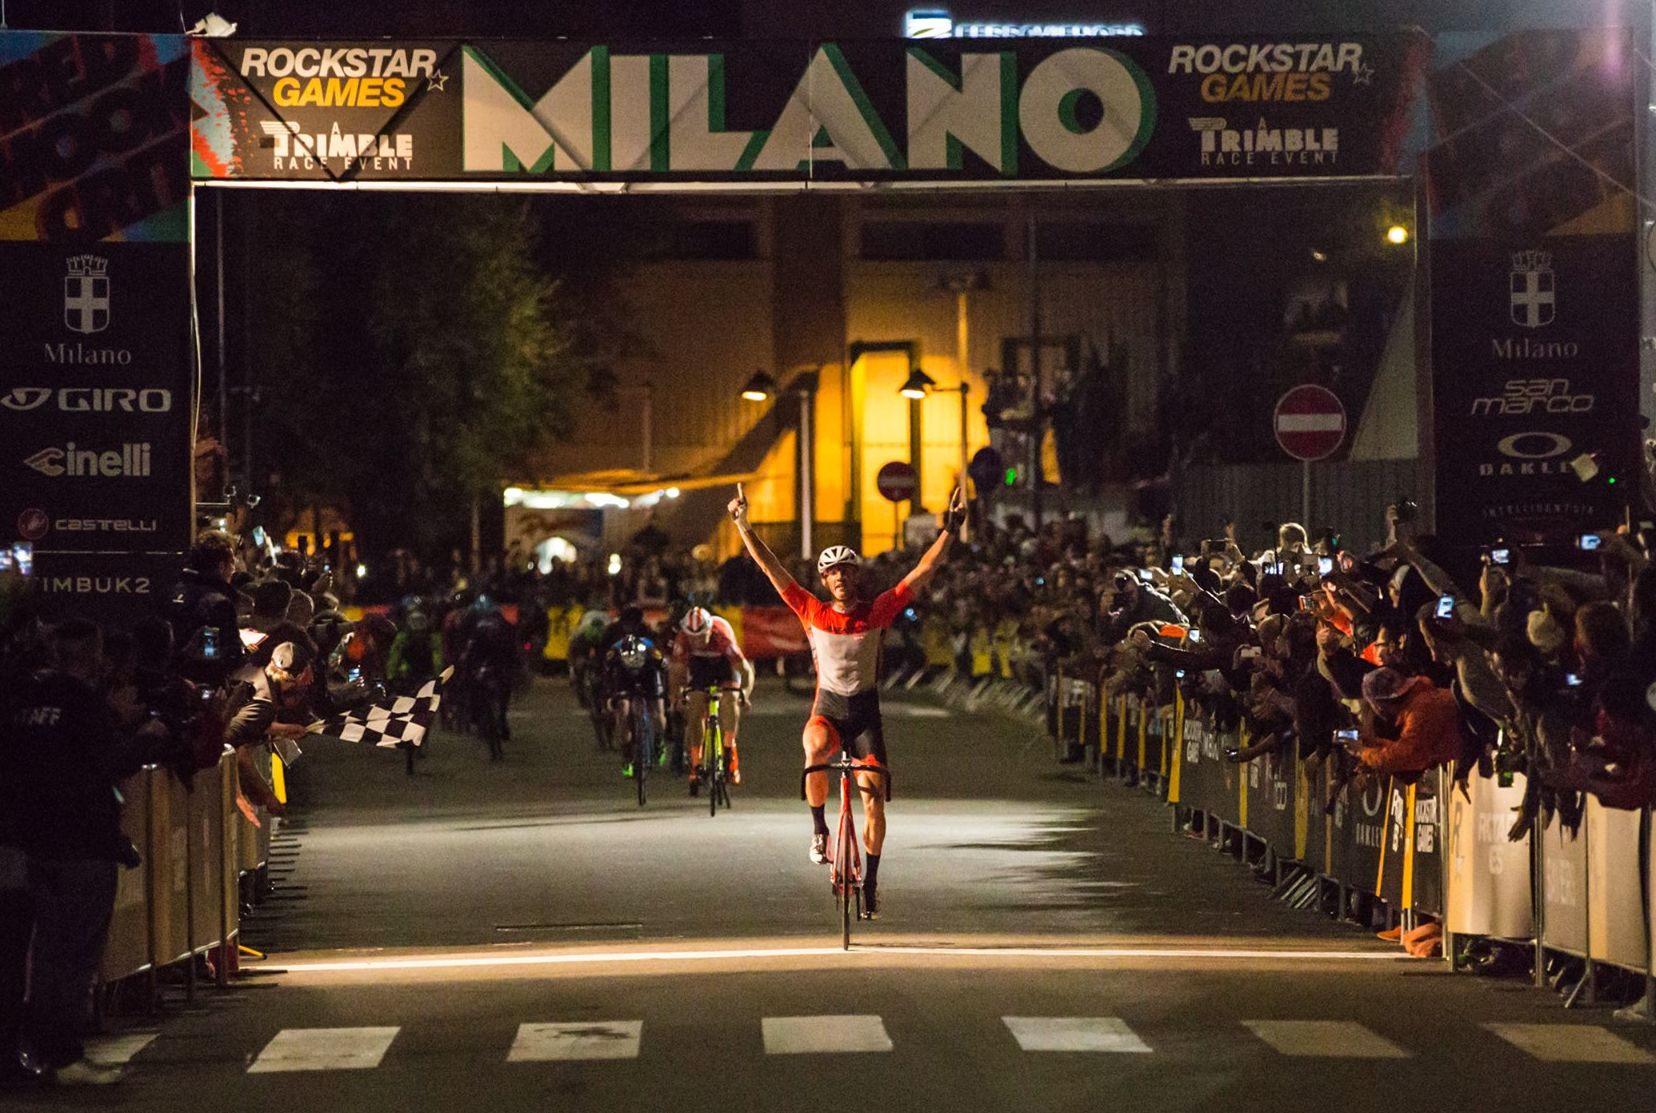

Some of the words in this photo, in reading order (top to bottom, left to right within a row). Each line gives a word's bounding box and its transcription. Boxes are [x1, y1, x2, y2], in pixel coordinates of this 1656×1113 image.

[241, 48, 437, 77] ROCKSTAR
[1168, 43, 1362, 74] ROCKSTAR
[273, 78, 406, 107] GAMES
[1201, 72, 1331, 103] GAMES
[462, 43, 1158, 173] MILANO
[260, 121, 413, 158] TRIMBLE
[1188, 117, 1339, 152] TRIMBLE
[274, 157, 328, 170] RACE
[345, 157, 412, 170] EVENT
[1201, 152, 1254, 165] RACE
[1271, 151, 1339, 165] EVENT
[45, 343, 132, 365] Milano
[1492, 338, 1578, 359] Milano
[57, 387, 172, 412] GIRO
[1480, 462, 1573, 476] OAKLE
